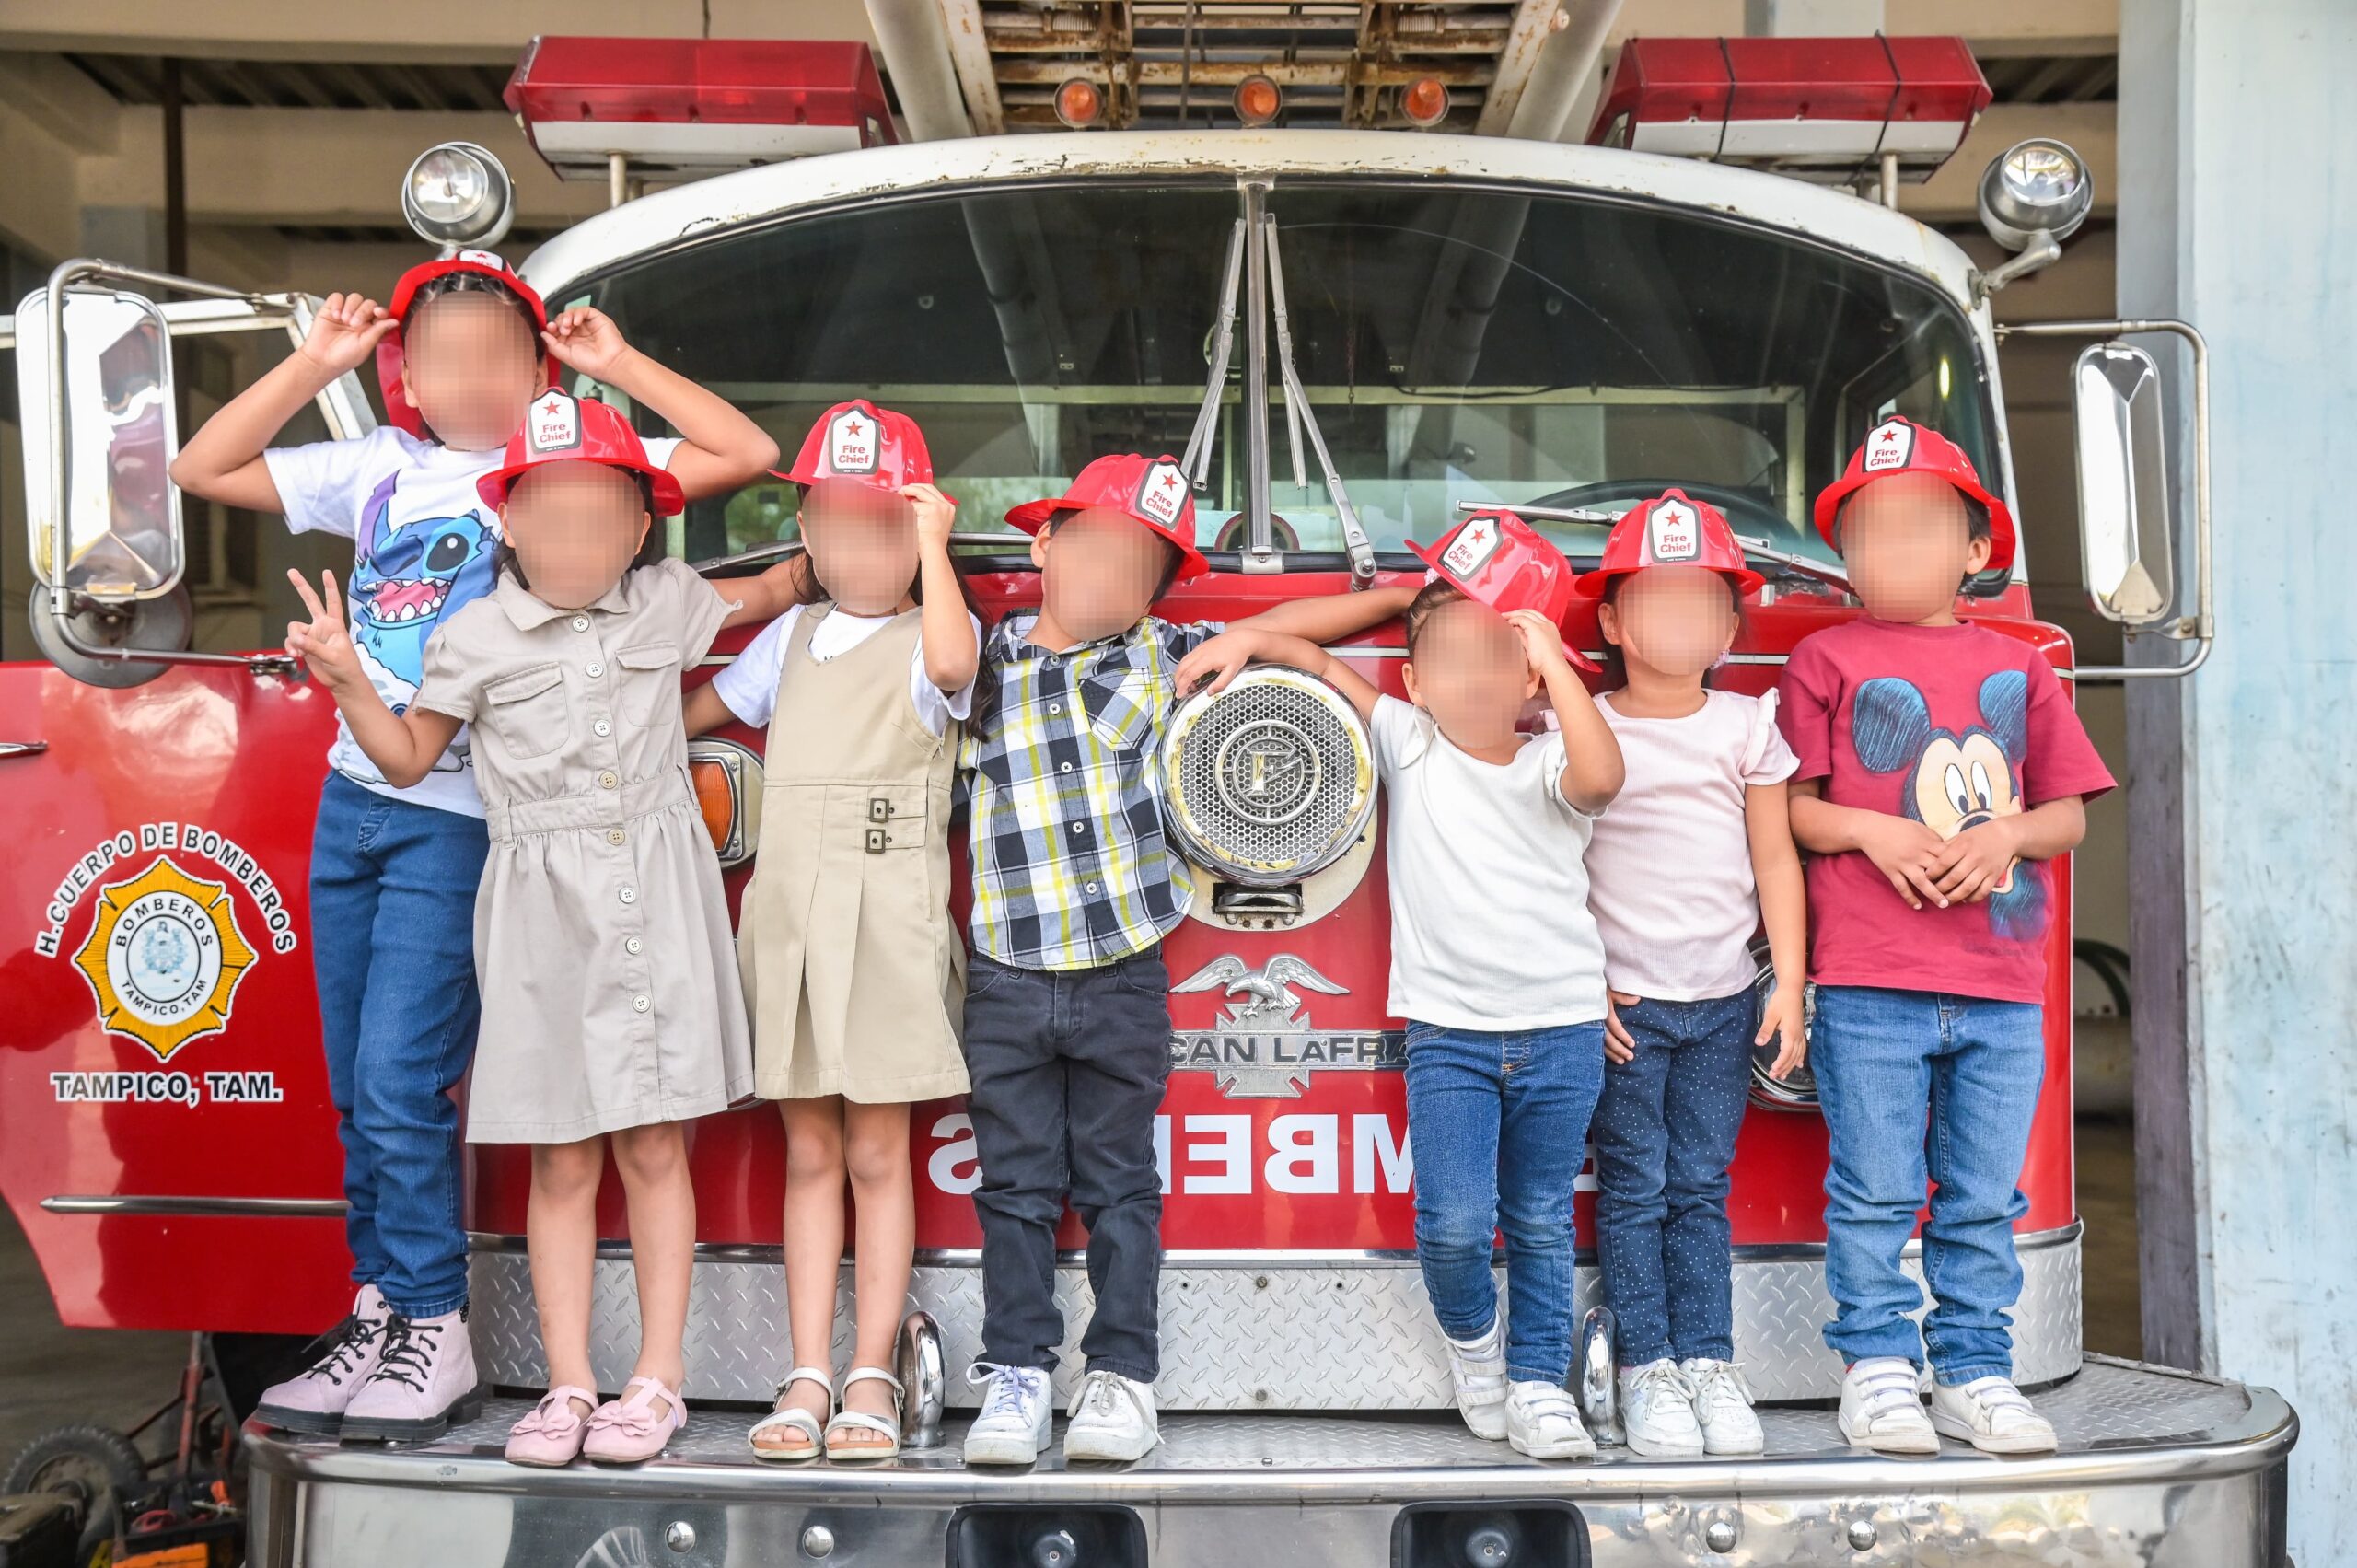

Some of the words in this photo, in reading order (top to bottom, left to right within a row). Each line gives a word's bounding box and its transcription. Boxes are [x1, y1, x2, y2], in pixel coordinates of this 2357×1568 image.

[542, 424, 566, 434] Fire
[540, 431, 571, 443] Chief
[842, 445, 865, 454] Fire
[1875, 449, 1898, 458] Fire
[838, 455, 869, 464] Chief
[1870, 456, 1900, 467] Chief
[1153, 490, 1173, 508] Fire
[1145, 497, 1174, 517] Chief
[1663, 534, 1687, 543] Fire
[1456, 543, 1473, 561] Fire
[1660, 542, 1691, 553] Chief
[1447, 551, 1471, 570] Chief
[144, 826, 174, 847] DE
[185, 829, 293, 951] BOMBEROS
[116, 898, 213, 947] BOMBEROS
[1169, 1037, 1257, 1063] CAN
[53, 1075, 197, 1104] TAMPICO,
[207, 1075, 280, 1098] TAM.
